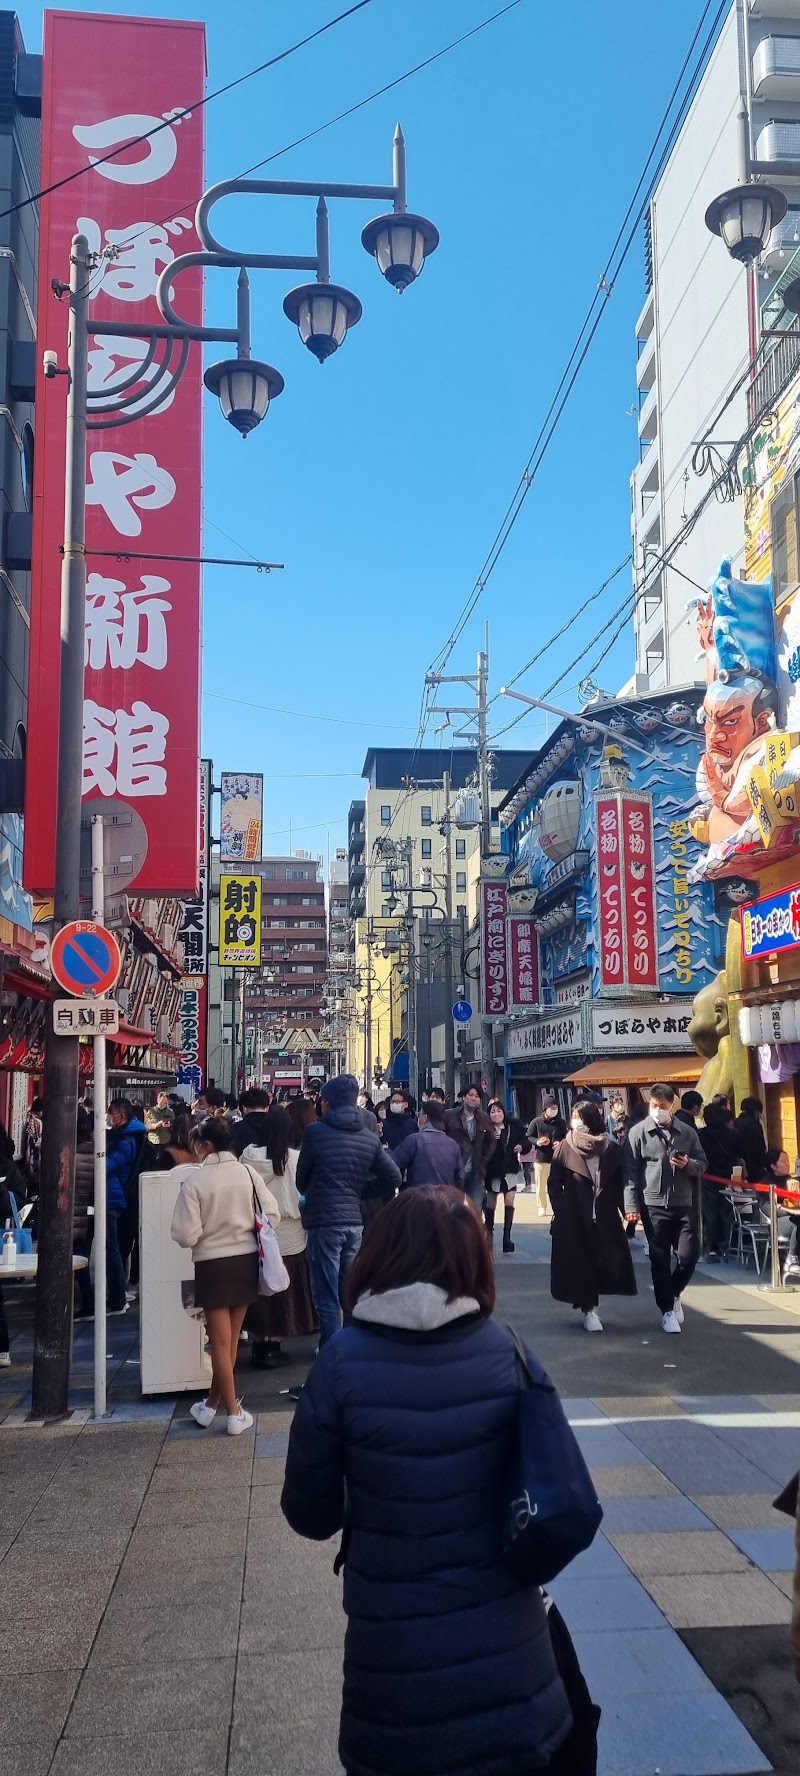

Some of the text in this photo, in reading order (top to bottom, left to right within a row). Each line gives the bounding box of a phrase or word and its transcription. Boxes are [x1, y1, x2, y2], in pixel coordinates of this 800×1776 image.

[72, 107, 193, 797] づぼらや新館
[224, 880, 258, 946] 射的
[601, 809, 621, 976] 名物 てっちり
[628, 811, 649, 977] 名物 てっちり
[75, 923, 97, 933] 9-22
[751, 909, 790, 943] 日本一の串かつ
[58, 1008, 116, 1027] 自動車
[598, 1016, 693, 1036] づぼらや本店
